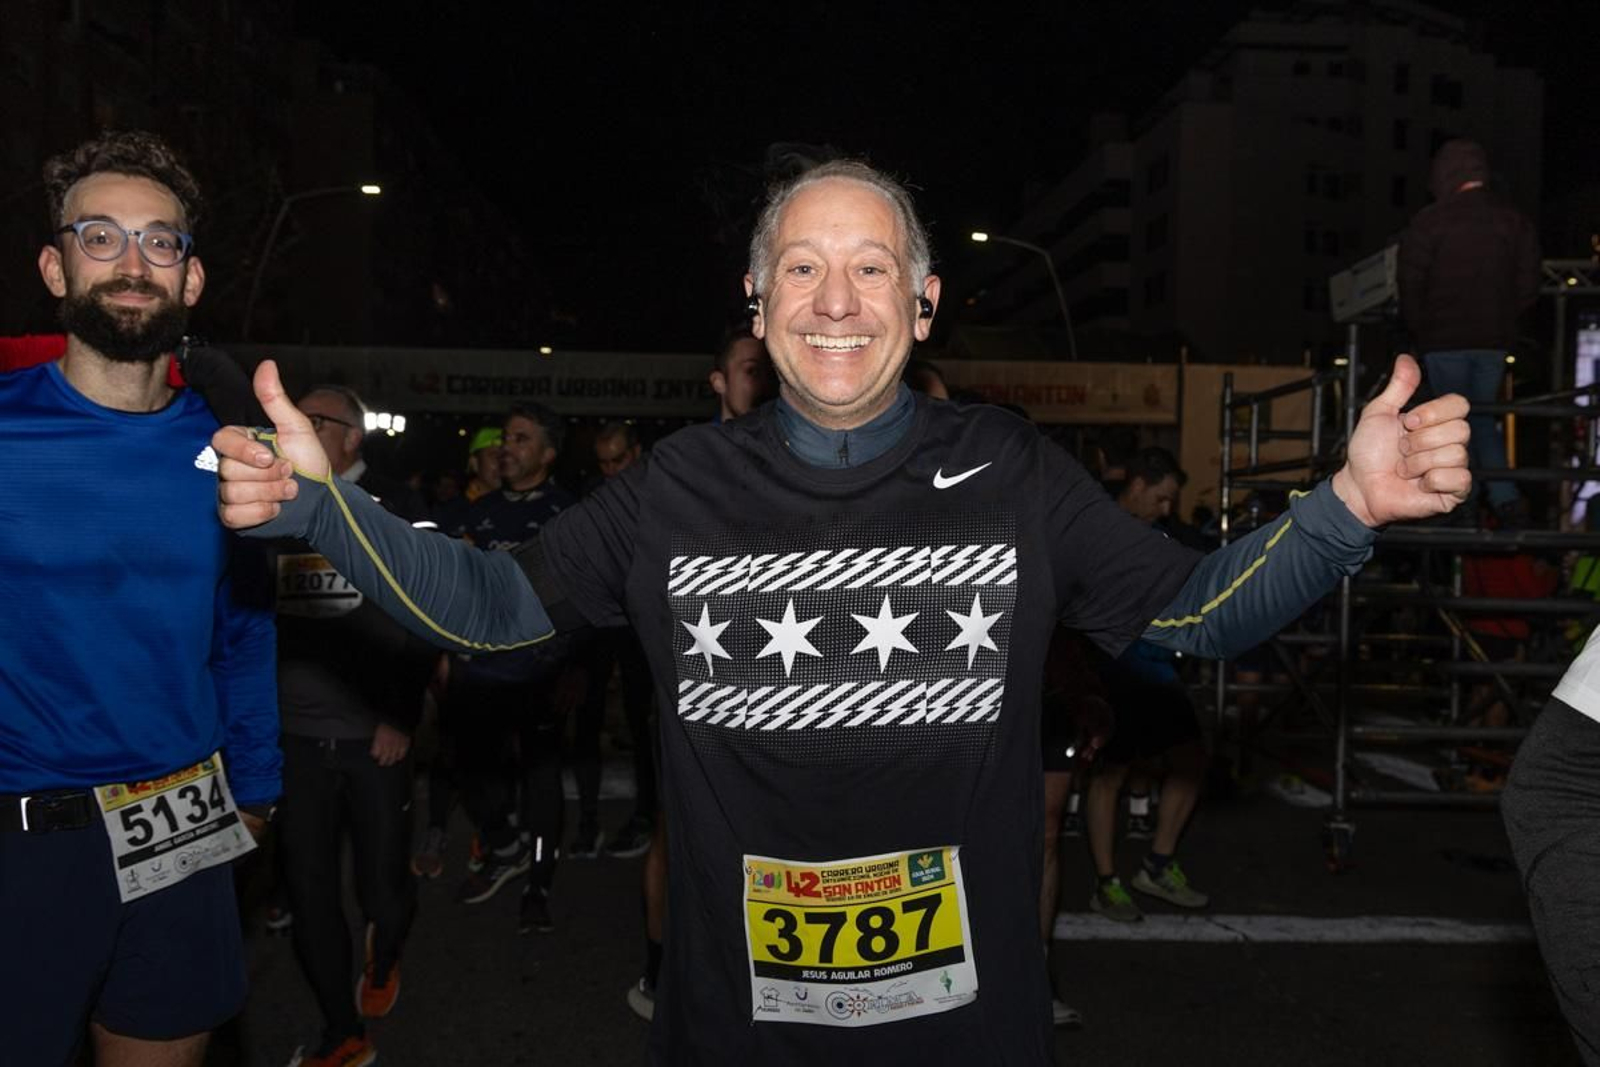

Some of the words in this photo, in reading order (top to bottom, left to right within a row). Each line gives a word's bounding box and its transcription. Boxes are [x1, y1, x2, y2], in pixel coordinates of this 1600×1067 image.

[446, 374, 551, 396] CARRERA
[556, 376, 647, 397] URBANA
[1012, 383, 1088, 406] ANTON
[120, 774, 226, 847] 5134
[785, 869, 822, 898] 42
[821, 866, 863, 879] CARRERA
[865, 860, 899, 873] URBANA
[822, 882, 852, 898] SAN
[854, 874, 902, 896] ANTON
[763, 892, 943, 964] 3787
[801, 969, 828, 980] JESUS
[830, 969, 871, 981] AGUILAR
[873, 961, 914, 978] ROMERO
